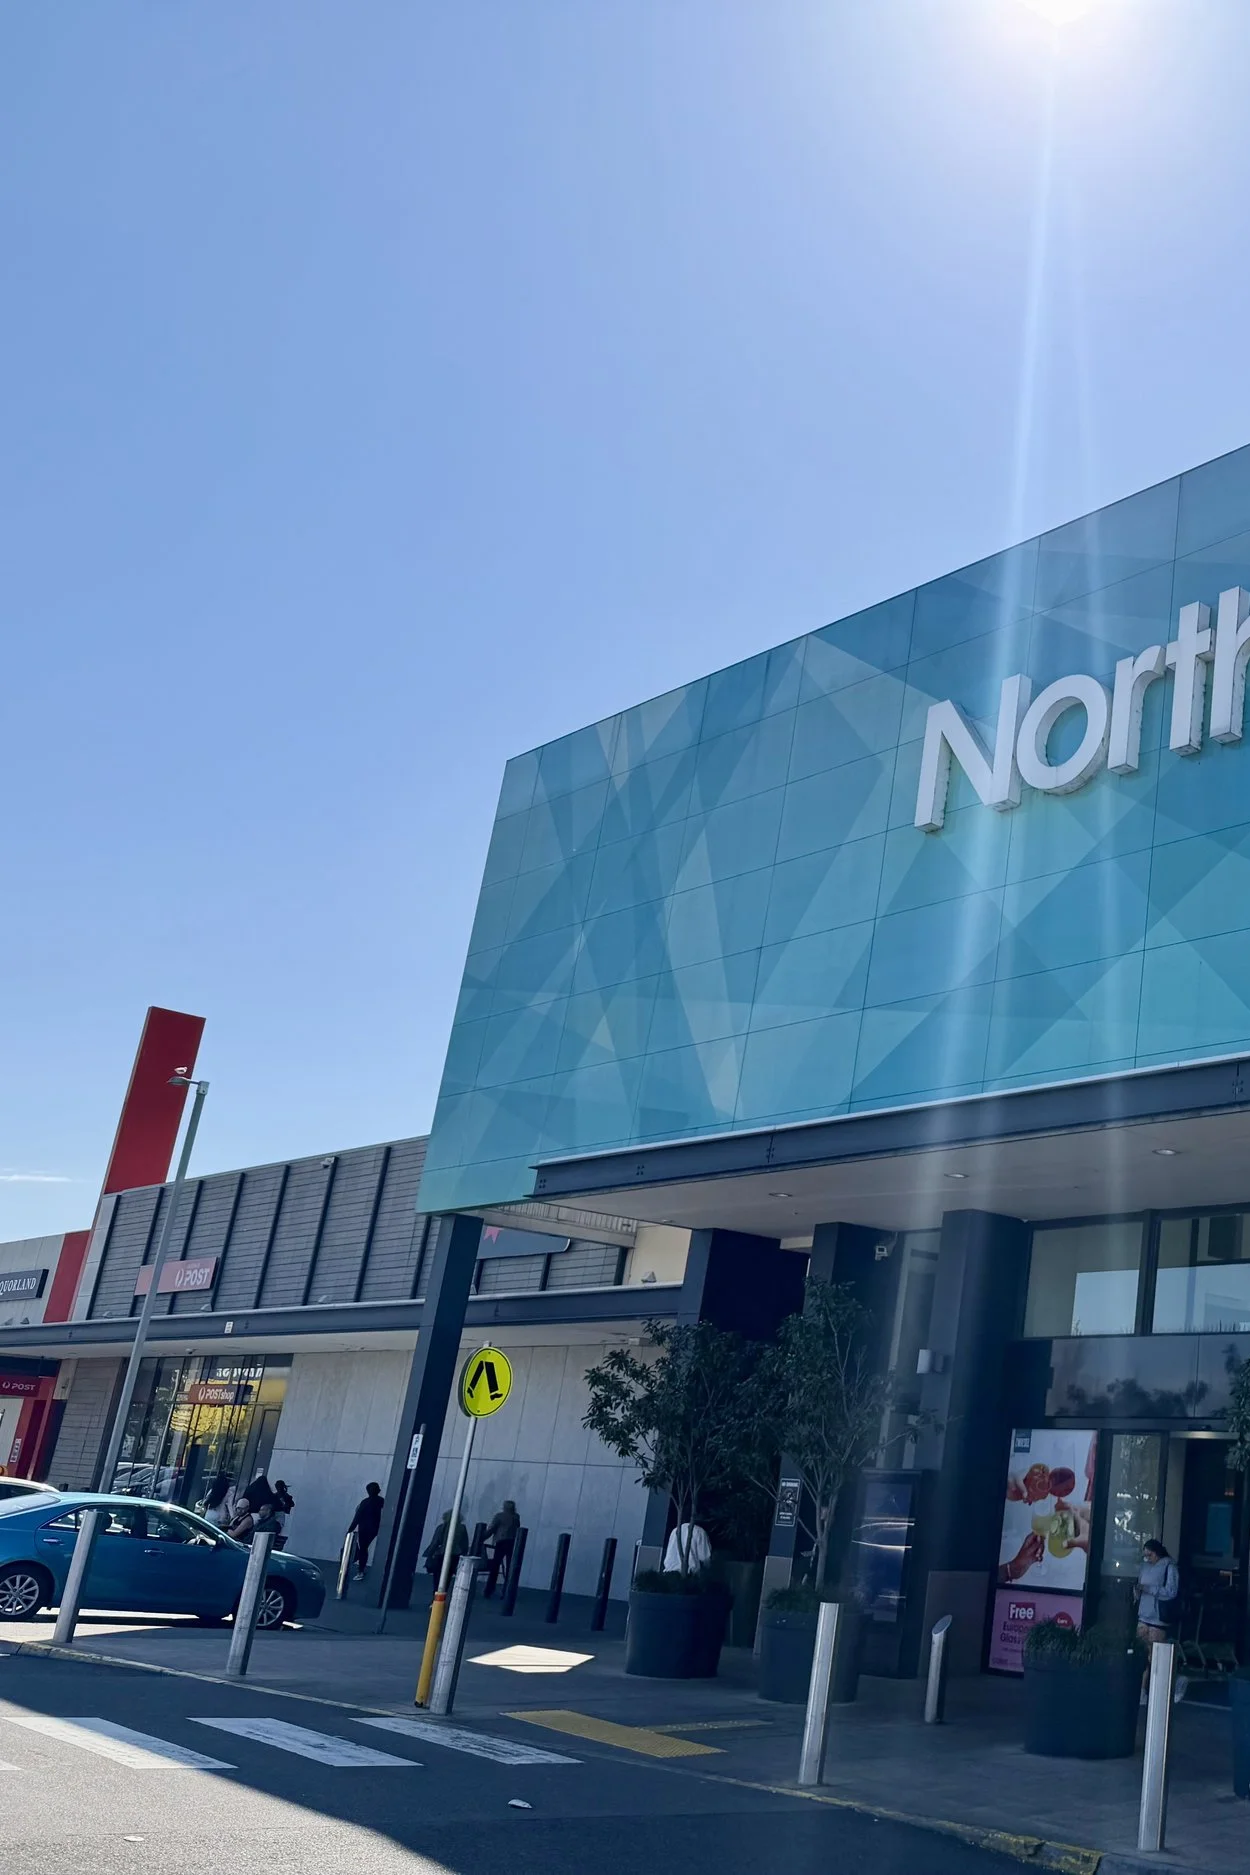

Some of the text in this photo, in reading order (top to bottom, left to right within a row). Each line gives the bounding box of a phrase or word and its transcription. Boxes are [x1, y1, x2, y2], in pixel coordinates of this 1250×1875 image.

[184, 1268, 210, 1286] POST
[11, 1383, 36, 1391] POST
[1009, 1603, 1034, 1620] Free
